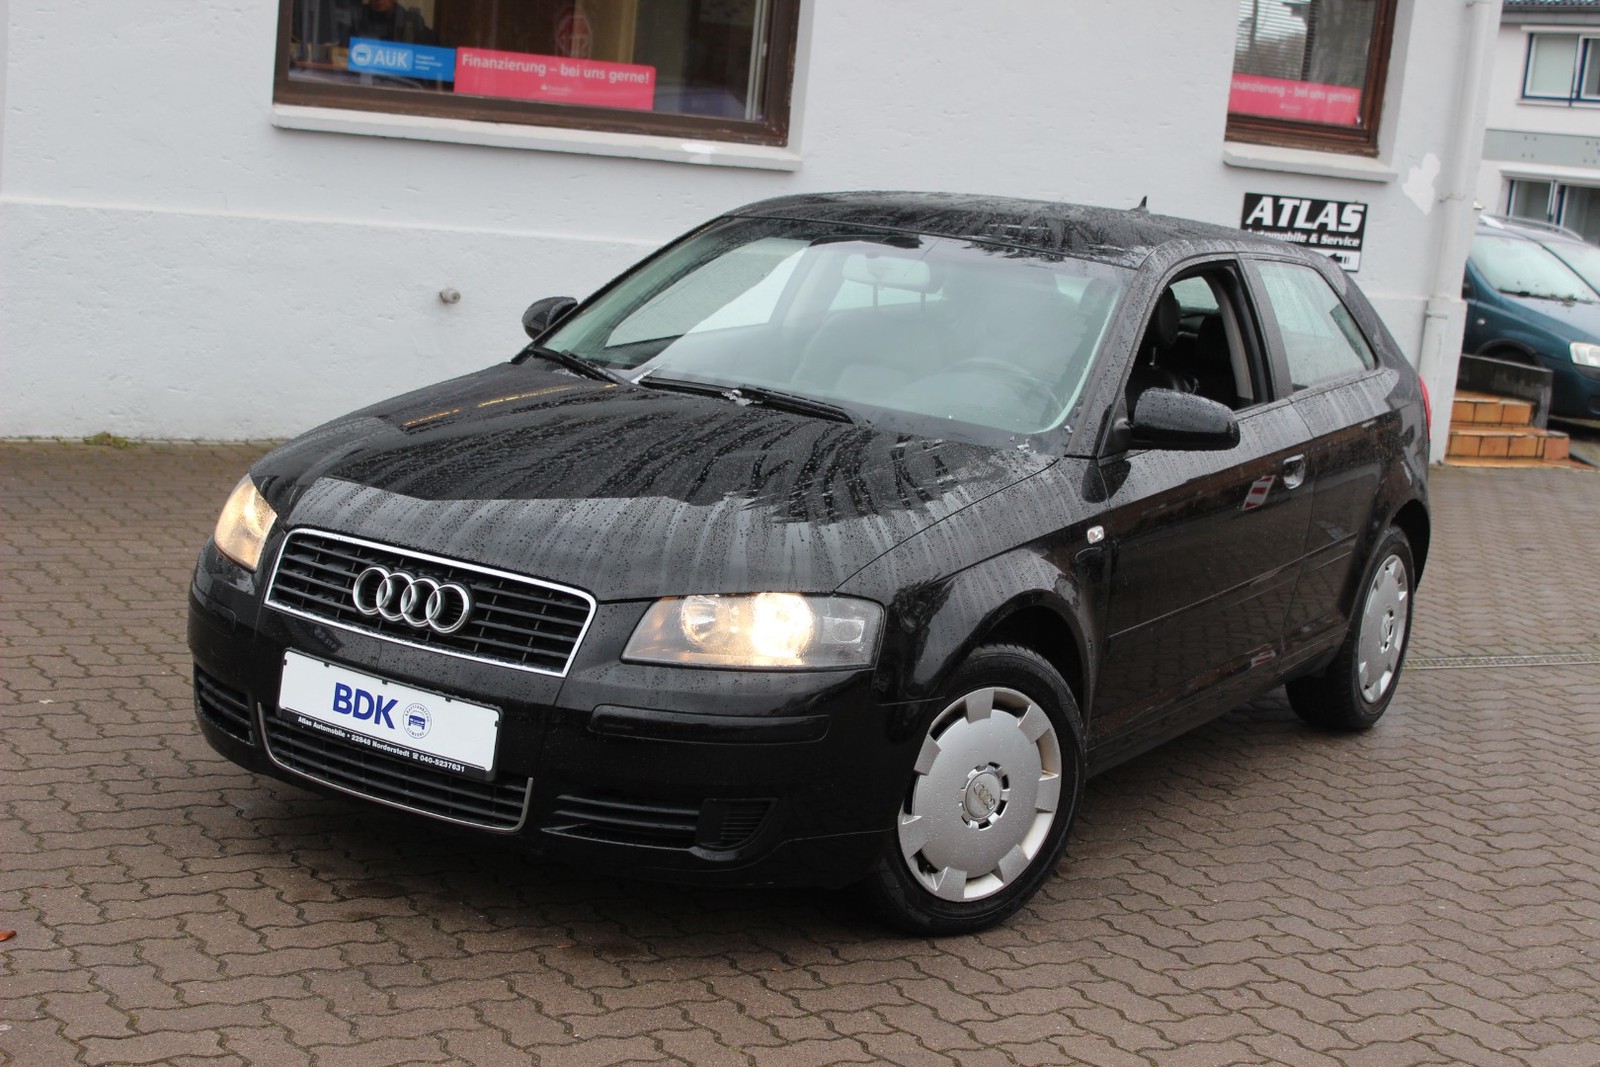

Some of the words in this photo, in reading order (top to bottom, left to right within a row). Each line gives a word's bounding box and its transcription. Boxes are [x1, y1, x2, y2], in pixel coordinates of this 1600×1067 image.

[461, 53, 546, 76] Finanzierung
[560, 63, 580, 77] bei
[583, 68, 606, 80] uns
[608, 70, 650, 84] gerne!
[1245, 196, 1365, 233] ATLAS
[1308, 233, 1318, 244] &
[1320, 233, 1360, 247] Service
[333, 682, 399, 730] BDK
[298, 716, 312, 726] Atlas
[313, 722, 346, 738] Automobile
[372, 740, 410, 758] Norderstedt
[419, 754, 465, 773] 040-5237631
